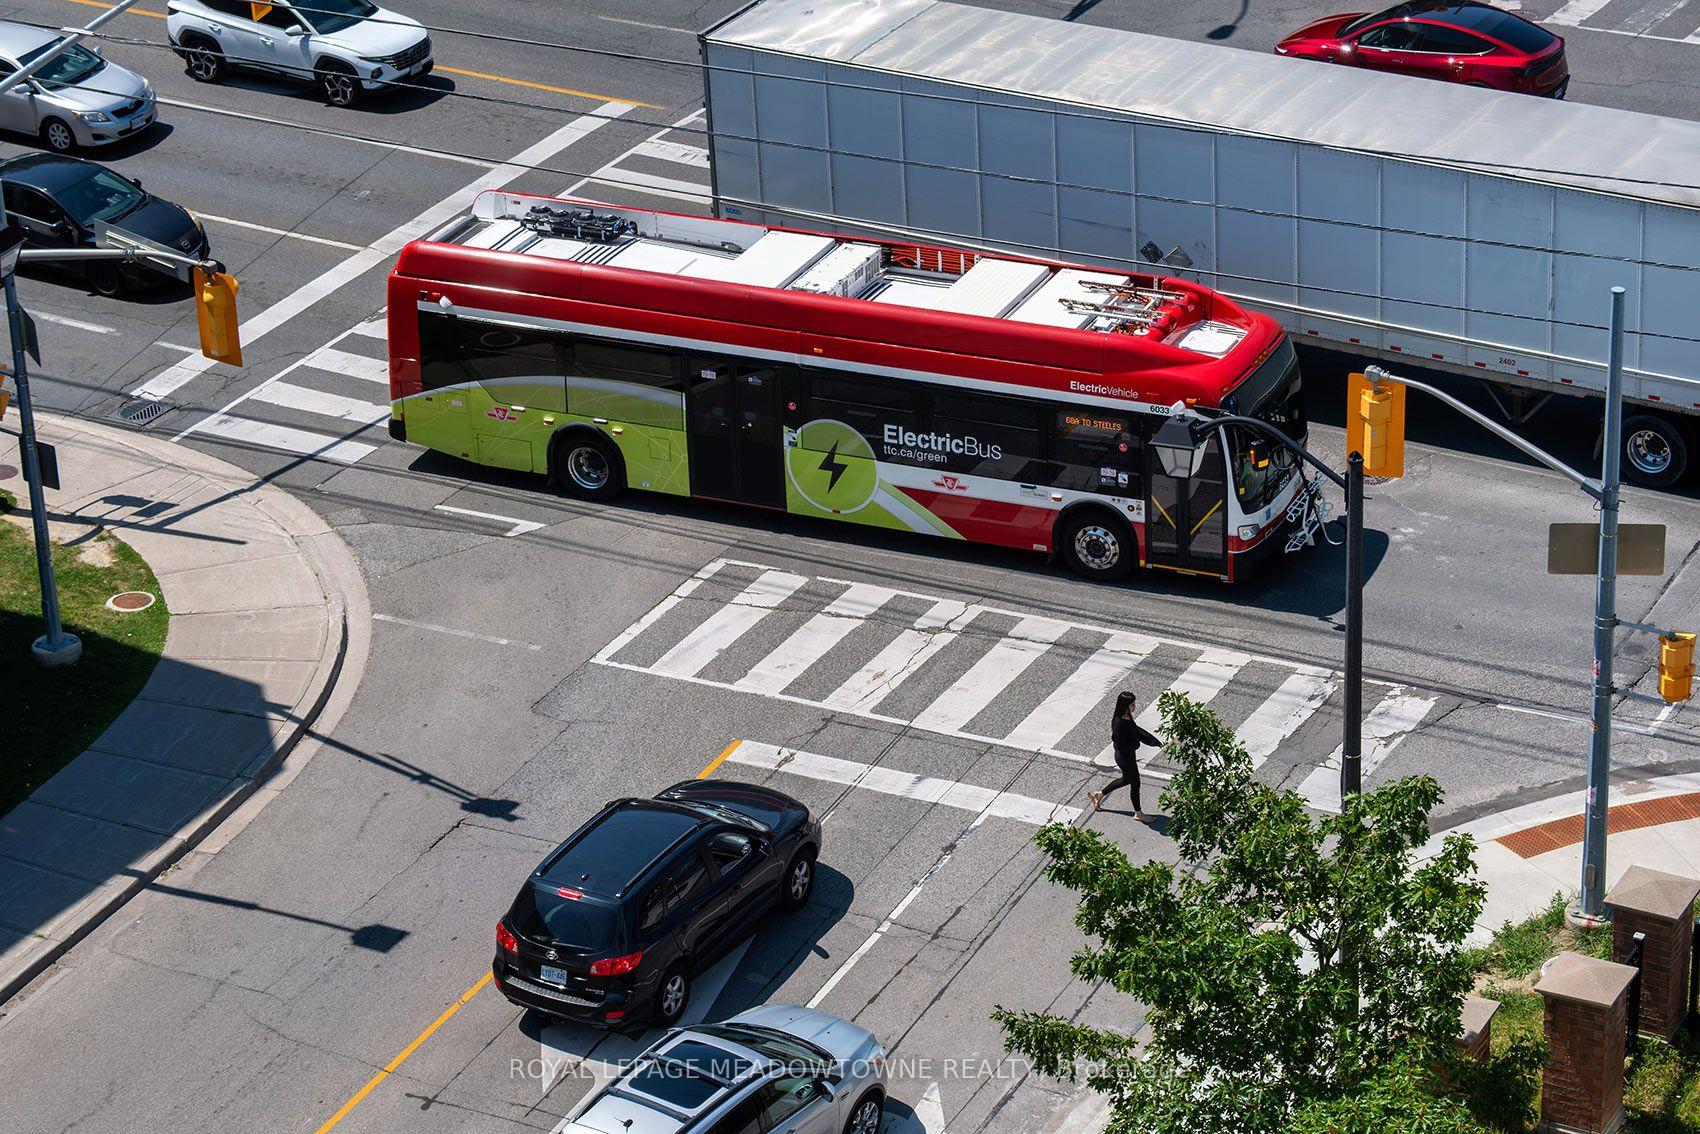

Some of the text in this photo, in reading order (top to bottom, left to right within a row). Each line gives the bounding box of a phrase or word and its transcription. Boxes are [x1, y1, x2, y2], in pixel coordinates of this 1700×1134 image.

[1070, 380, 1139, 399] ElectricVehicle
[1150, 404, 1170, 415] 6033
[1081, 418, 1091, 428] TO
[1093, 421, 1122, 432] STEELES
[883, 424, 1002, 460] ElectricBus
[883, 445, 948, 463] ttc.ca/green
